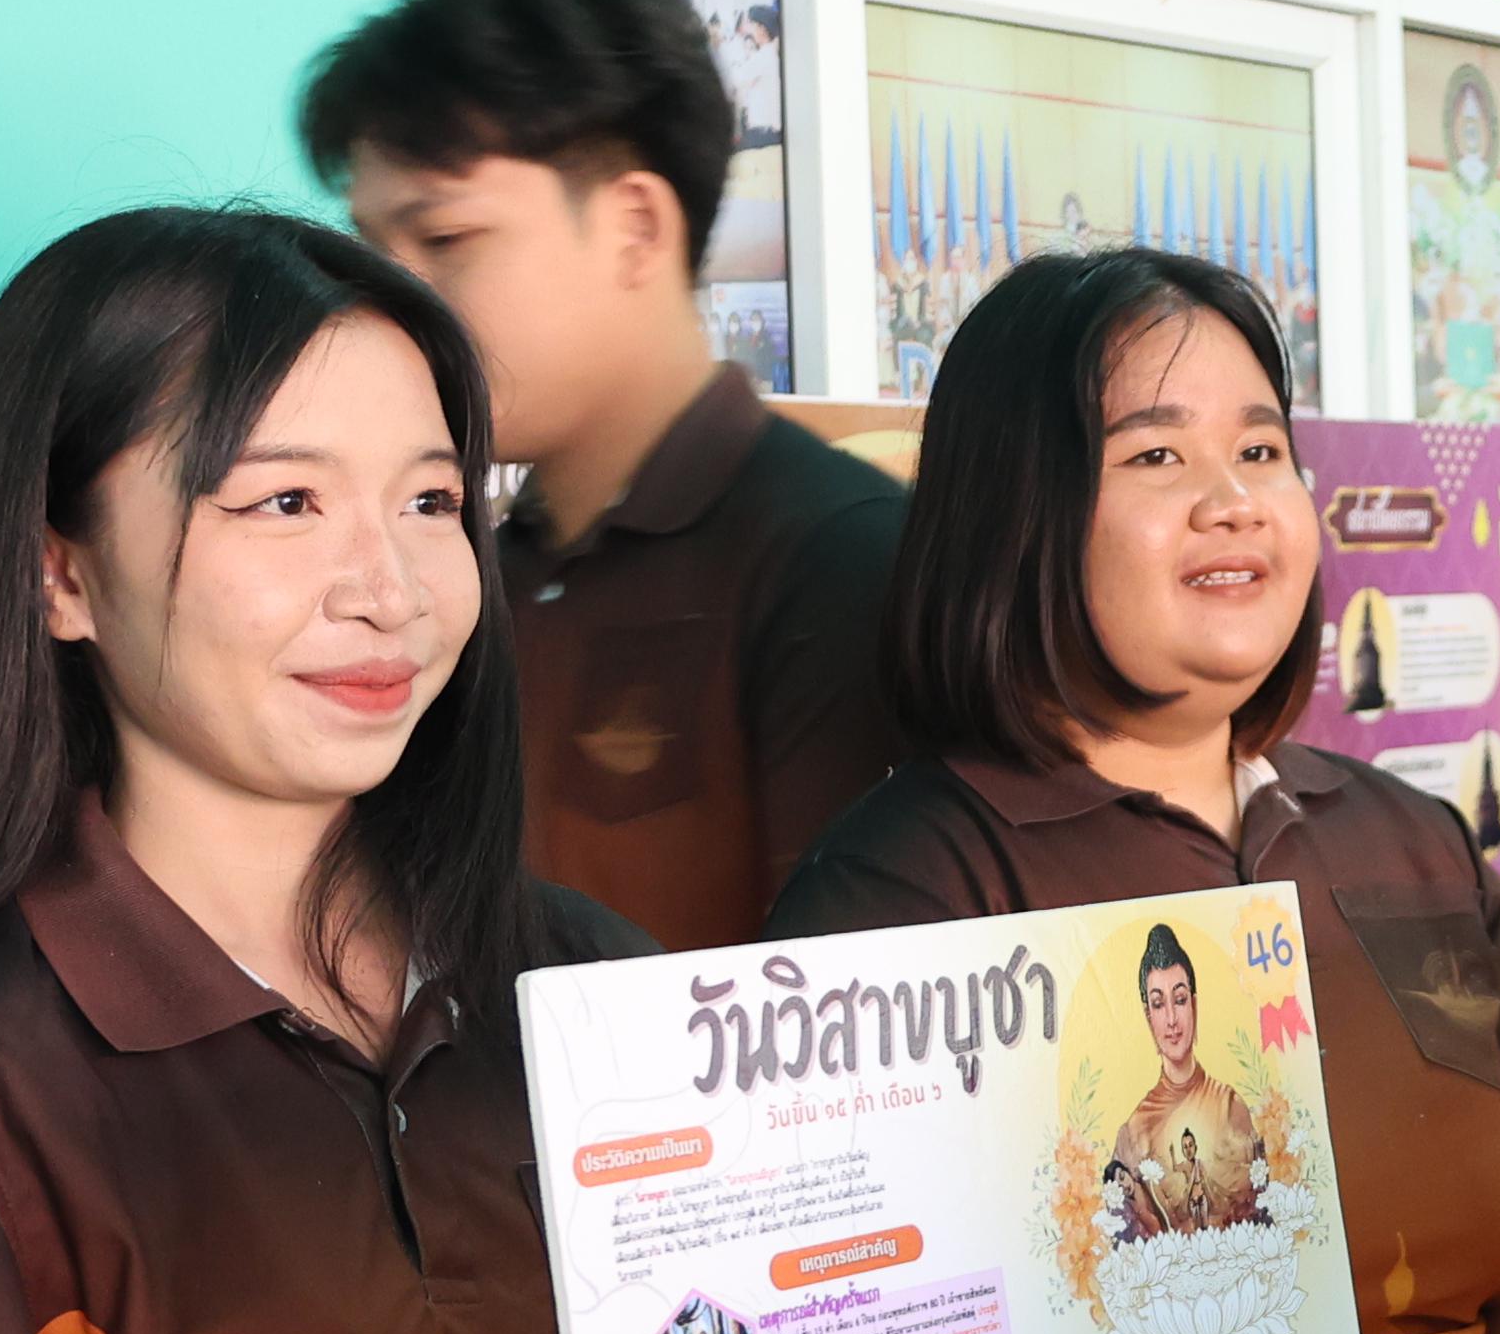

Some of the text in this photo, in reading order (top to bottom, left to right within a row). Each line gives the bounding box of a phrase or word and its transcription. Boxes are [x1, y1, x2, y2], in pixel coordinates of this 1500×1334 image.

[1244, 920, 1297, 977] 46
[687, 943, 1058, 1097] วันวิสาขบูชา
[766, 1080, 943, 1130] วันขึ้น ๑๕ ค่ำ เดือน ๖
[581, 1137, 703, 1174] ประวัติความเป็นมา
[799, 1236, 899, 1274] เหตุการณ์สำคัญ
